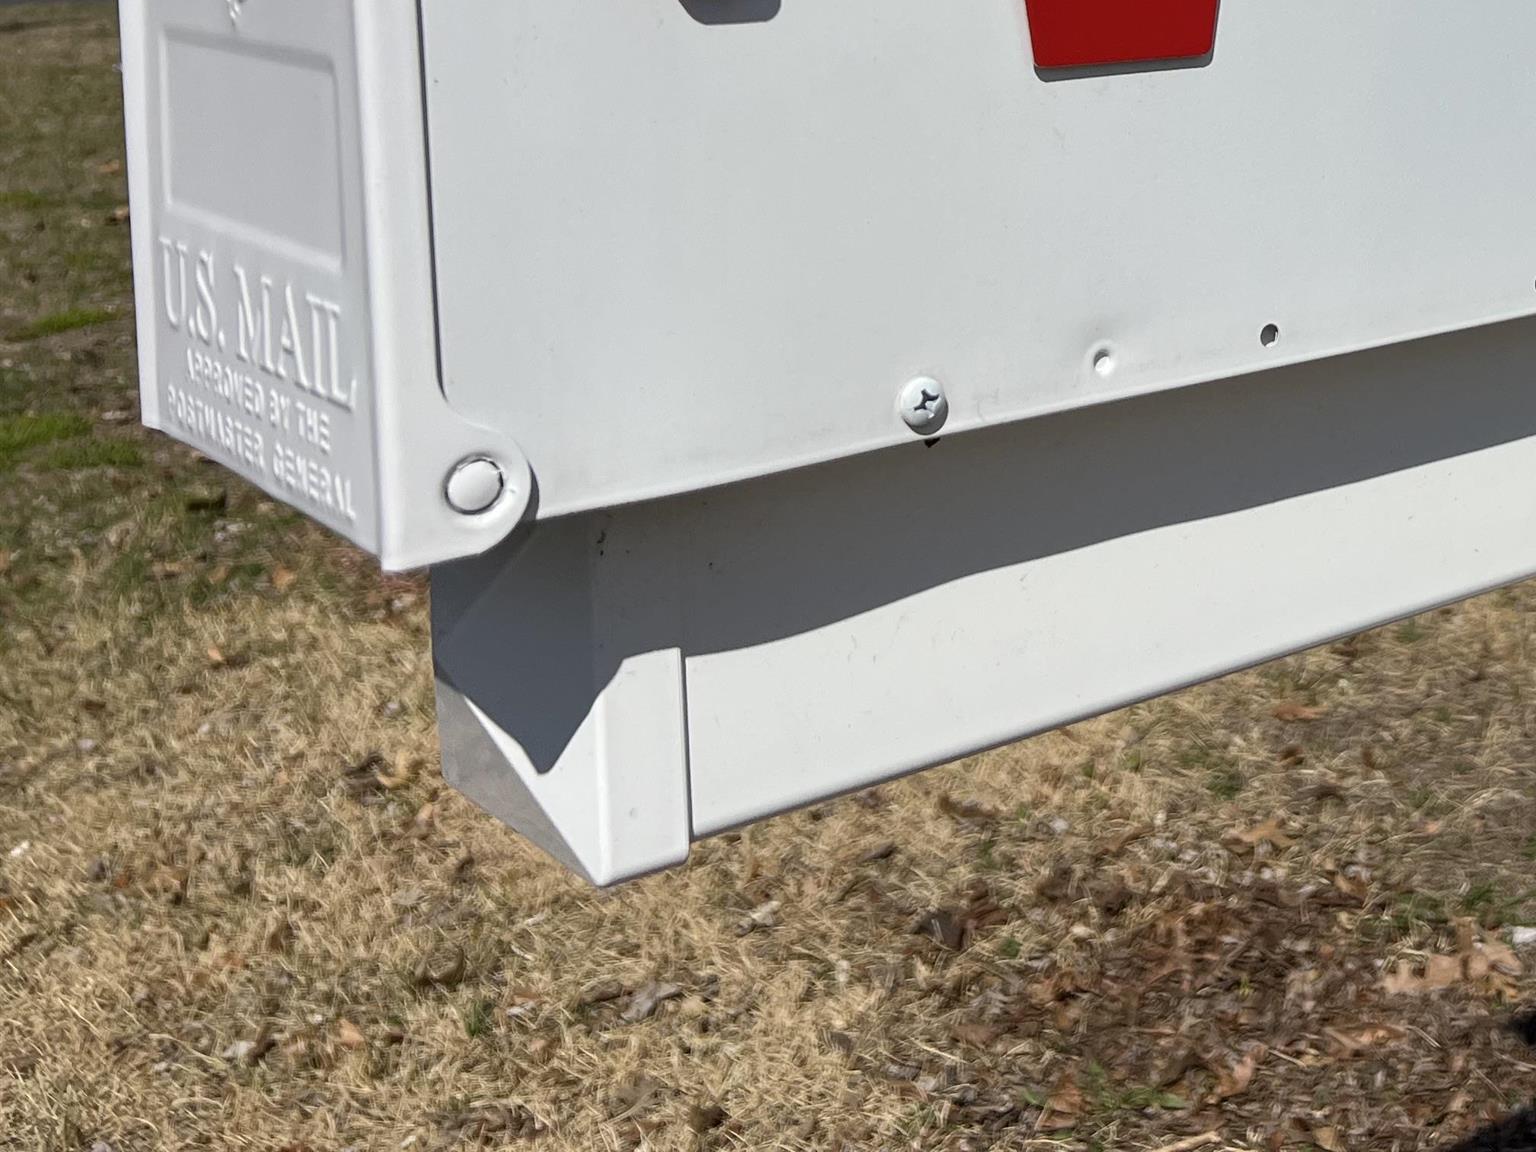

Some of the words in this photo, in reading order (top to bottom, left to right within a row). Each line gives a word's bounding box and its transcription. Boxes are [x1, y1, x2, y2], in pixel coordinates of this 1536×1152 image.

[159, 236, 226, 351] U.S.
[234, 264, 357, 413] MAIL
[167, 383, 265, 471] POSTMASTER
[272, 442, 357, 520] GENERAL
[186, 348, 265, 419] APPROVED
[269, 388, 291, 431] BY
[296, 401, 331, 454] THE
